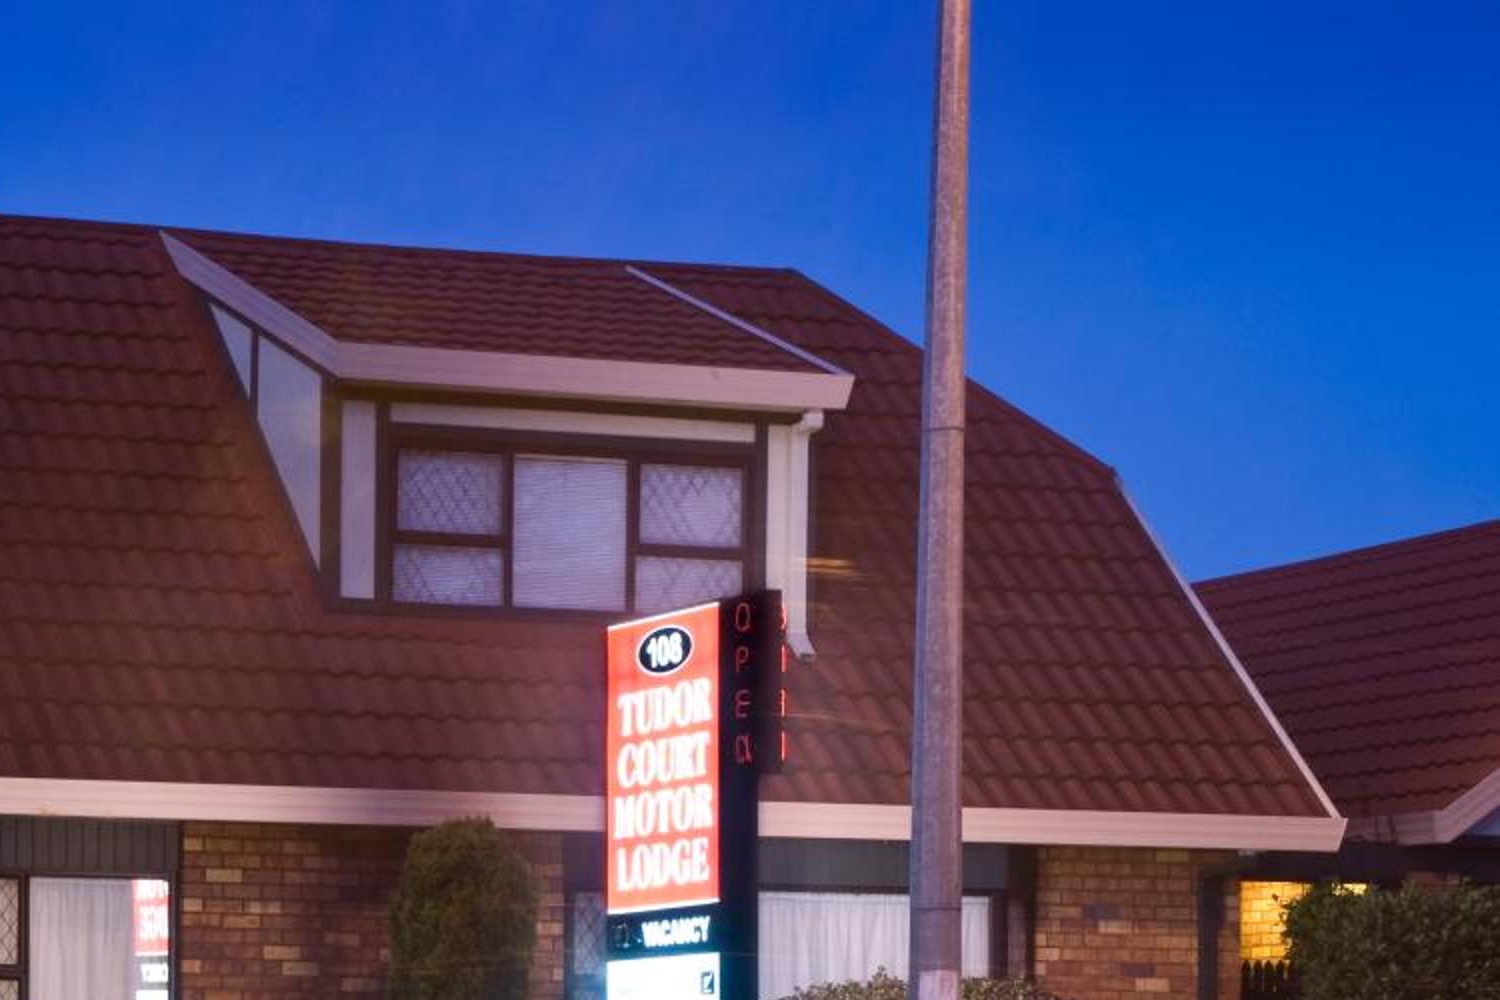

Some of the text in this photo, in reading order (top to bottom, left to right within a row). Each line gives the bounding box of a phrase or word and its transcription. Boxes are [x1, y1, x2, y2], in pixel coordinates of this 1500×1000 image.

[646, 632, 683, 668] 108
[617, 677, 712, 736] TUDOR
[617, 731, 710, 789] COURT
[614, 784, 713, 840] MOTOR
[617, 837, 709, 892] LODGE
[642, 915, 711, 947] VACANCY
